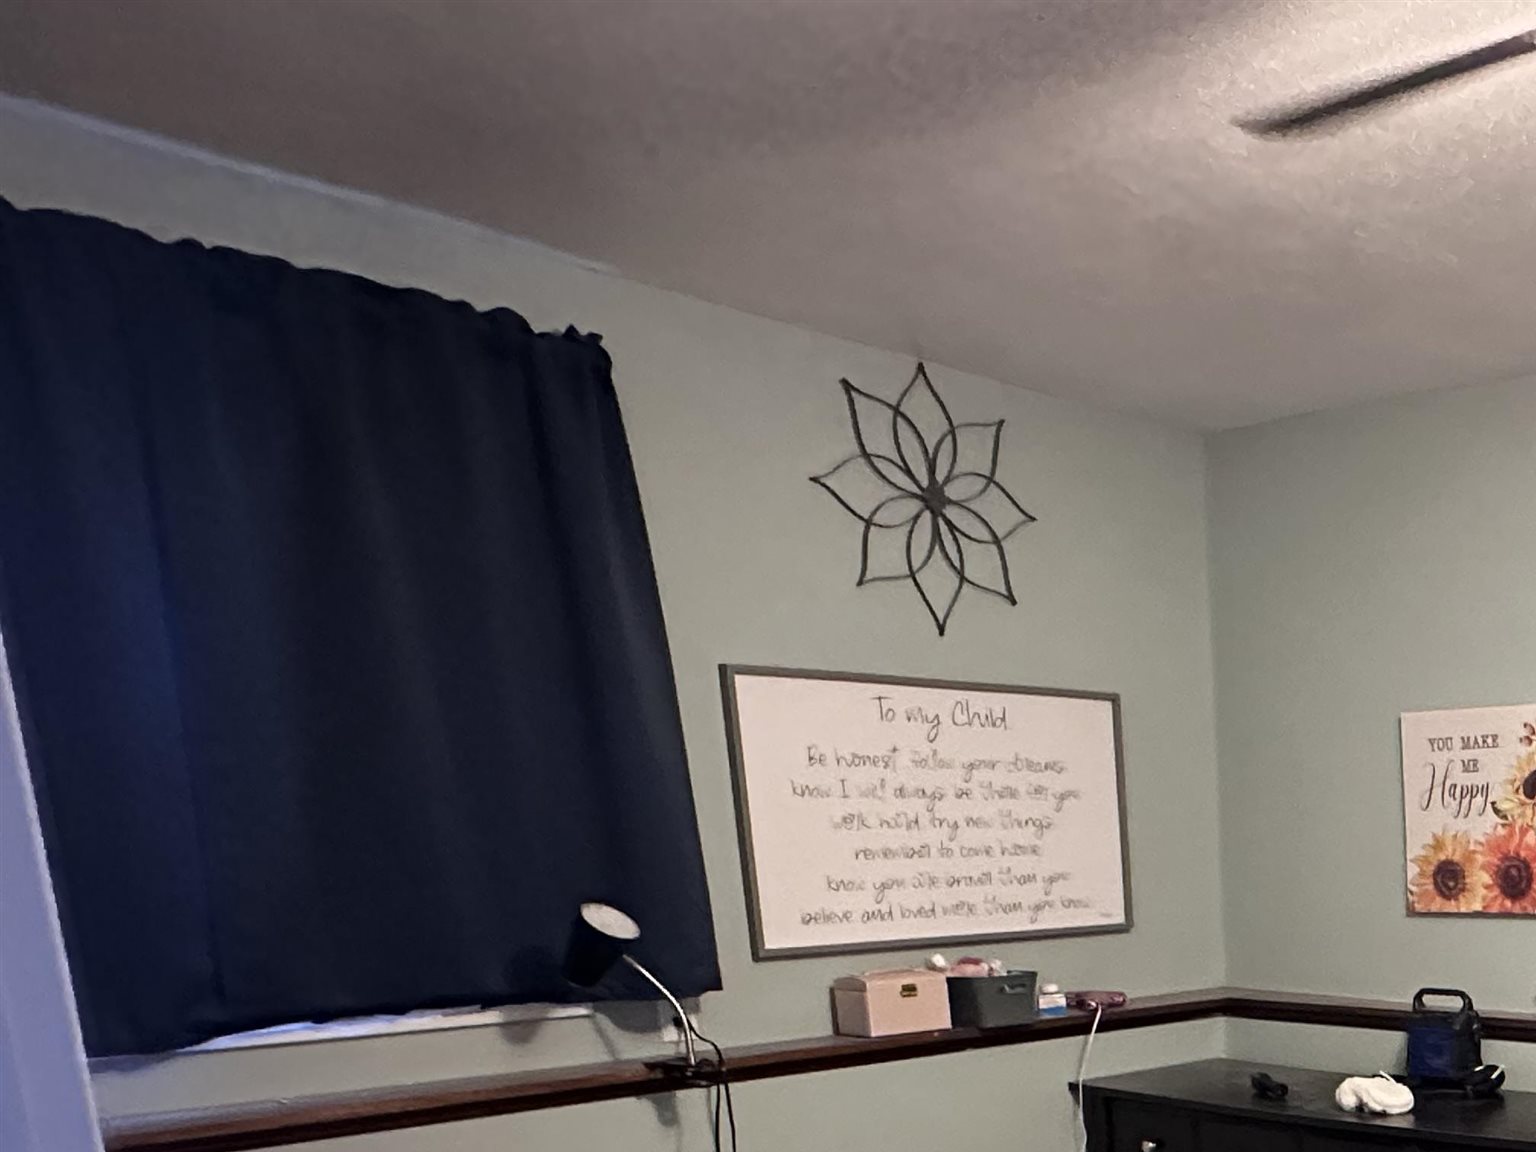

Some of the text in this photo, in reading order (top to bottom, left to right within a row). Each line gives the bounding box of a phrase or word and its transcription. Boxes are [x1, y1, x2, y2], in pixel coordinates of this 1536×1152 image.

[869, 695, 1008, 744] To my Child
[1427, 733, 1500, 752] YOU MAKE
[806, 744, 828, 767] Be
[834, 744, 900, 773] honest
[961, 757, 1001, 783] your
[1460, 758, 1480, 774] ME
[838, 777, 850, 800] I
[893, 783, 946, 813] always
[953, 783, 974, 800] be
[1051, 788, 1081, 814] you
[1418, 759, 1490, 820] Happy
[998, 808, 1053, 841] things
[854, 844, 932, 861] remember
[937, 839, 955, 859] to
[960, 845, 995, 859] come
[872, 876, 907, 905] you
[800, 905, 854, 926] believe
[860, 904, 894, 925] and
[899, 901, 938, 921] loved
